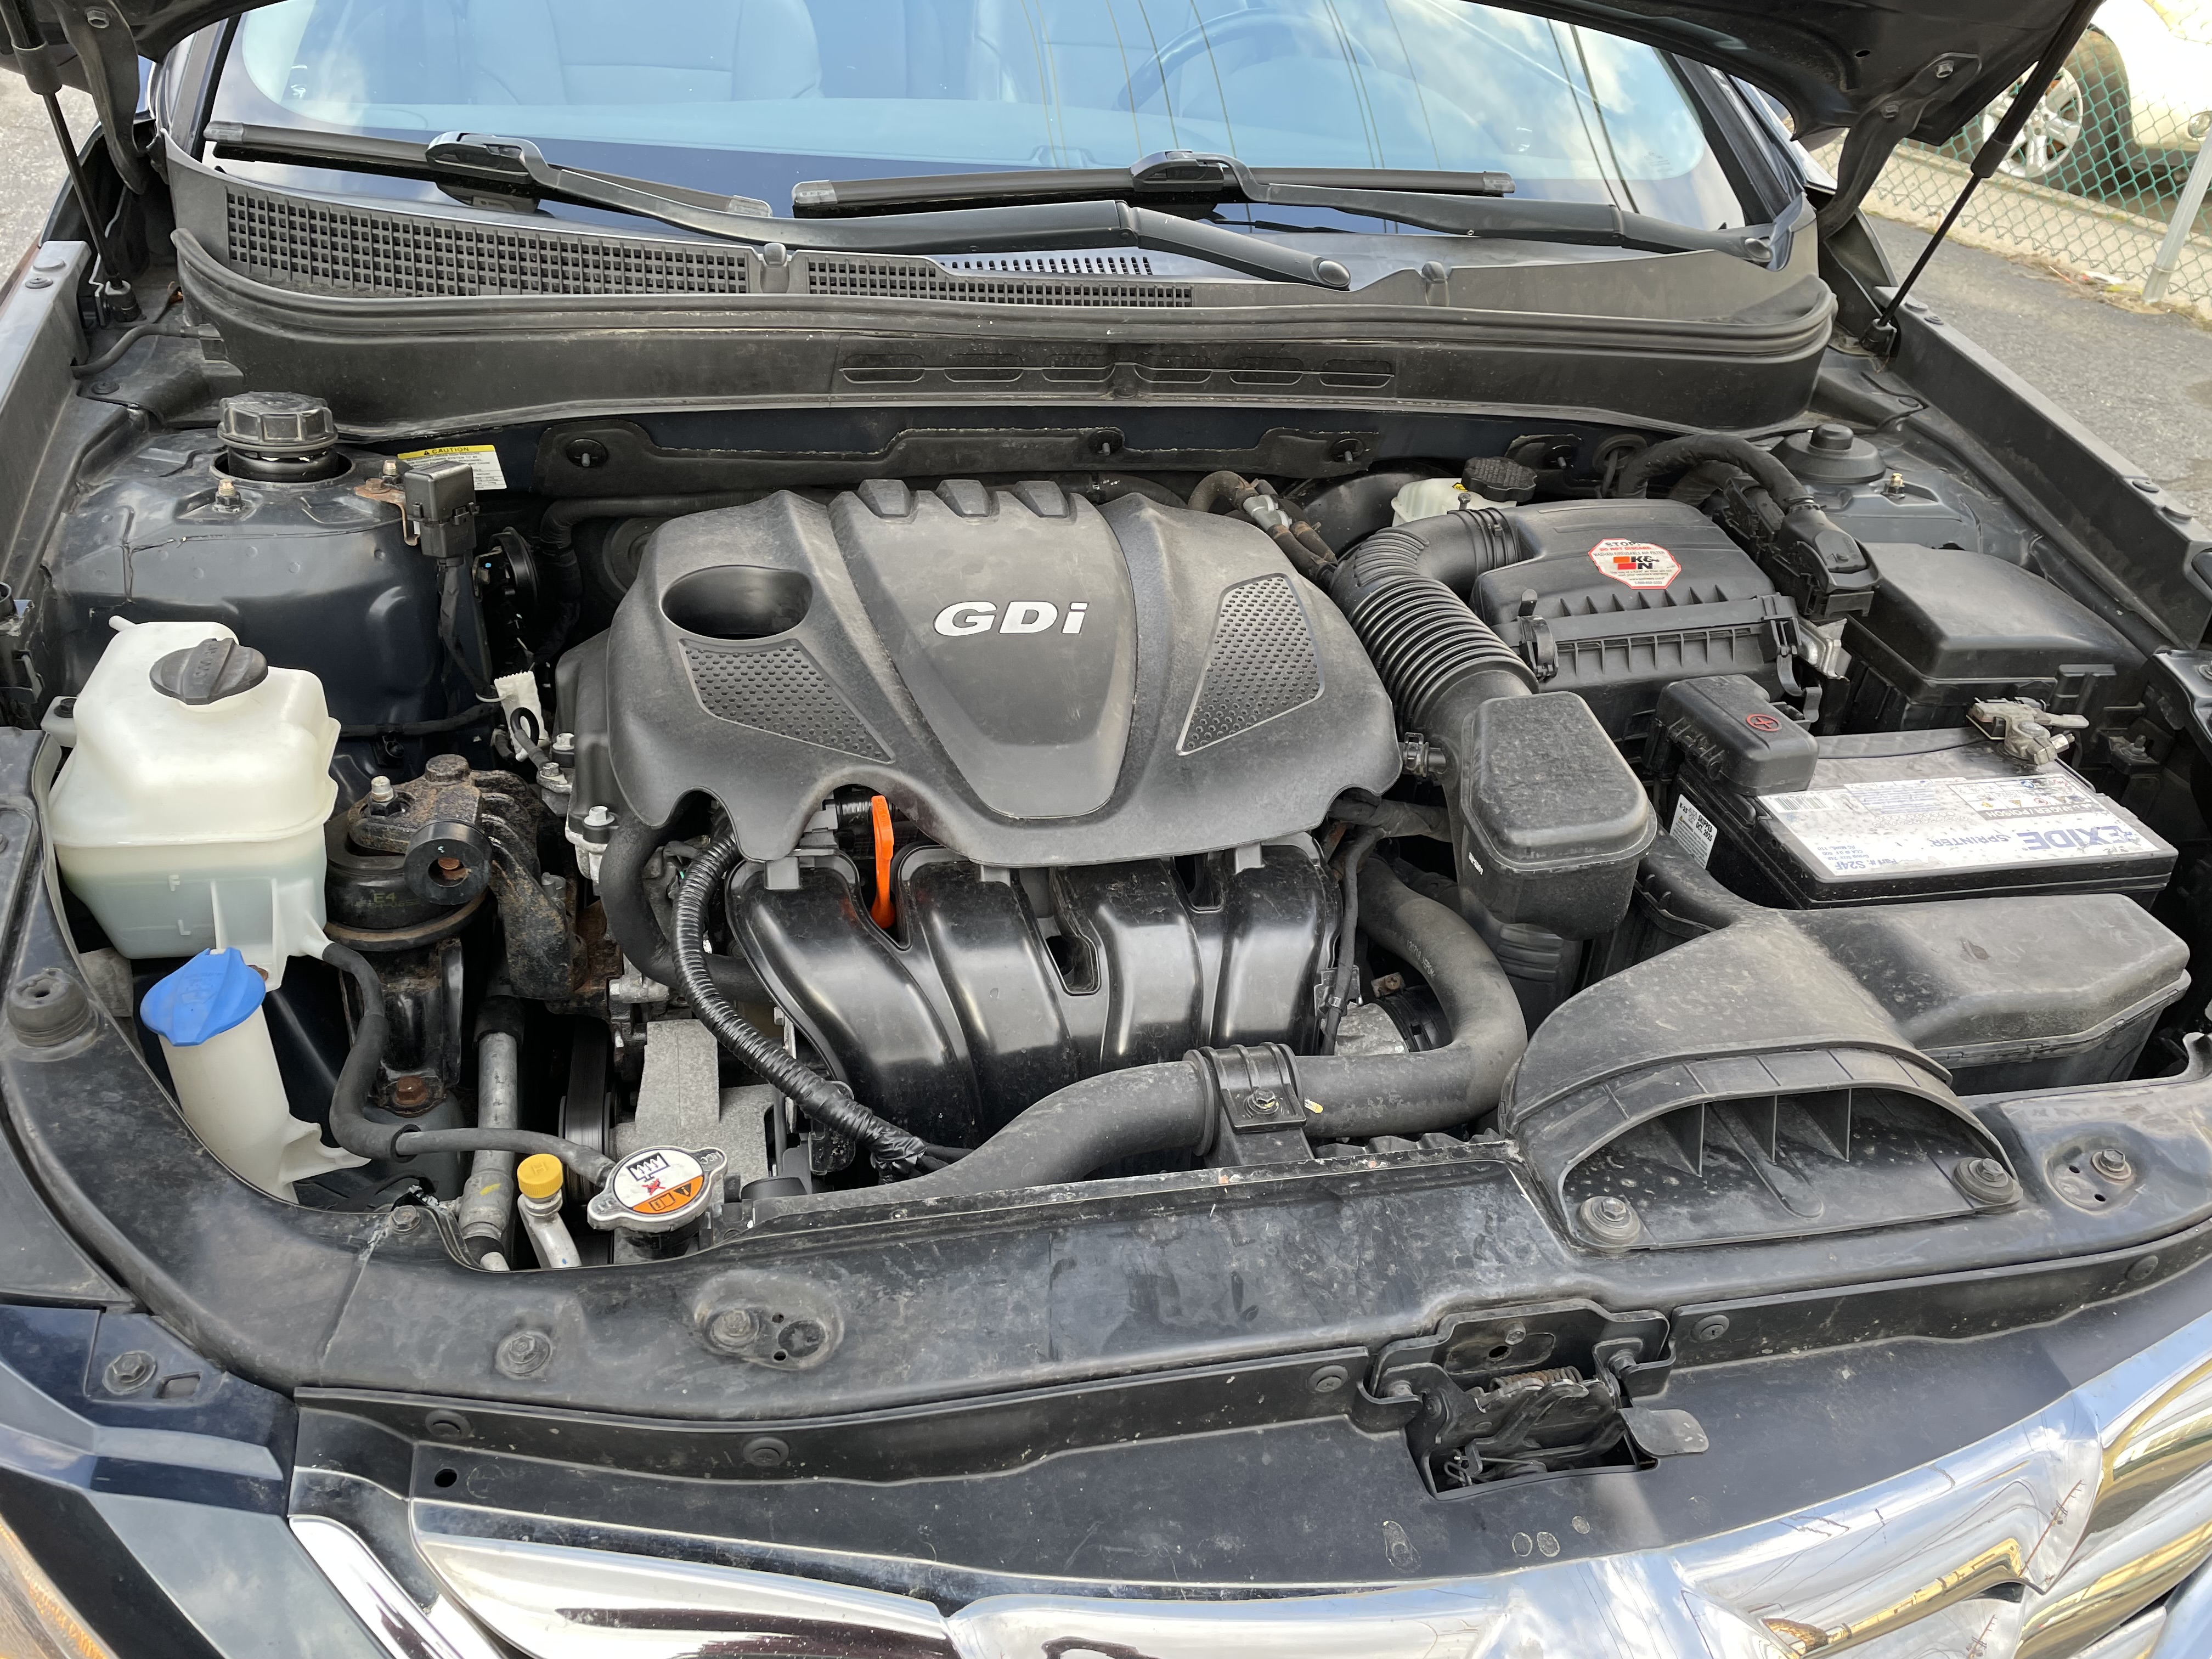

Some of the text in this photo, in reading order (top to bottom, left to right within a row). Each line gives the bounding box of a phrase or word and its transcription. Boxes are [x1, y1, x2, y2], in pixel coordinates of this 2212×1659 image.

[934, 600, 1090, 636] GDi
[1985, 808, 2029, 817] POISON
[1697, 815, 1713, 833] SHIPPED
[1703, 829, 1713, 842] 2025
[1927, 834, 2009, 847] SPRINTER
[2016, 825, 2130, 851] EXIDE
[1835, 860, 1866, 870] S24F
[169, 874, 180, 891] F
[373, 892, 396, 903] E4
[178, 919, 191, 936] L
[532, 1162, 548, 1175] H
